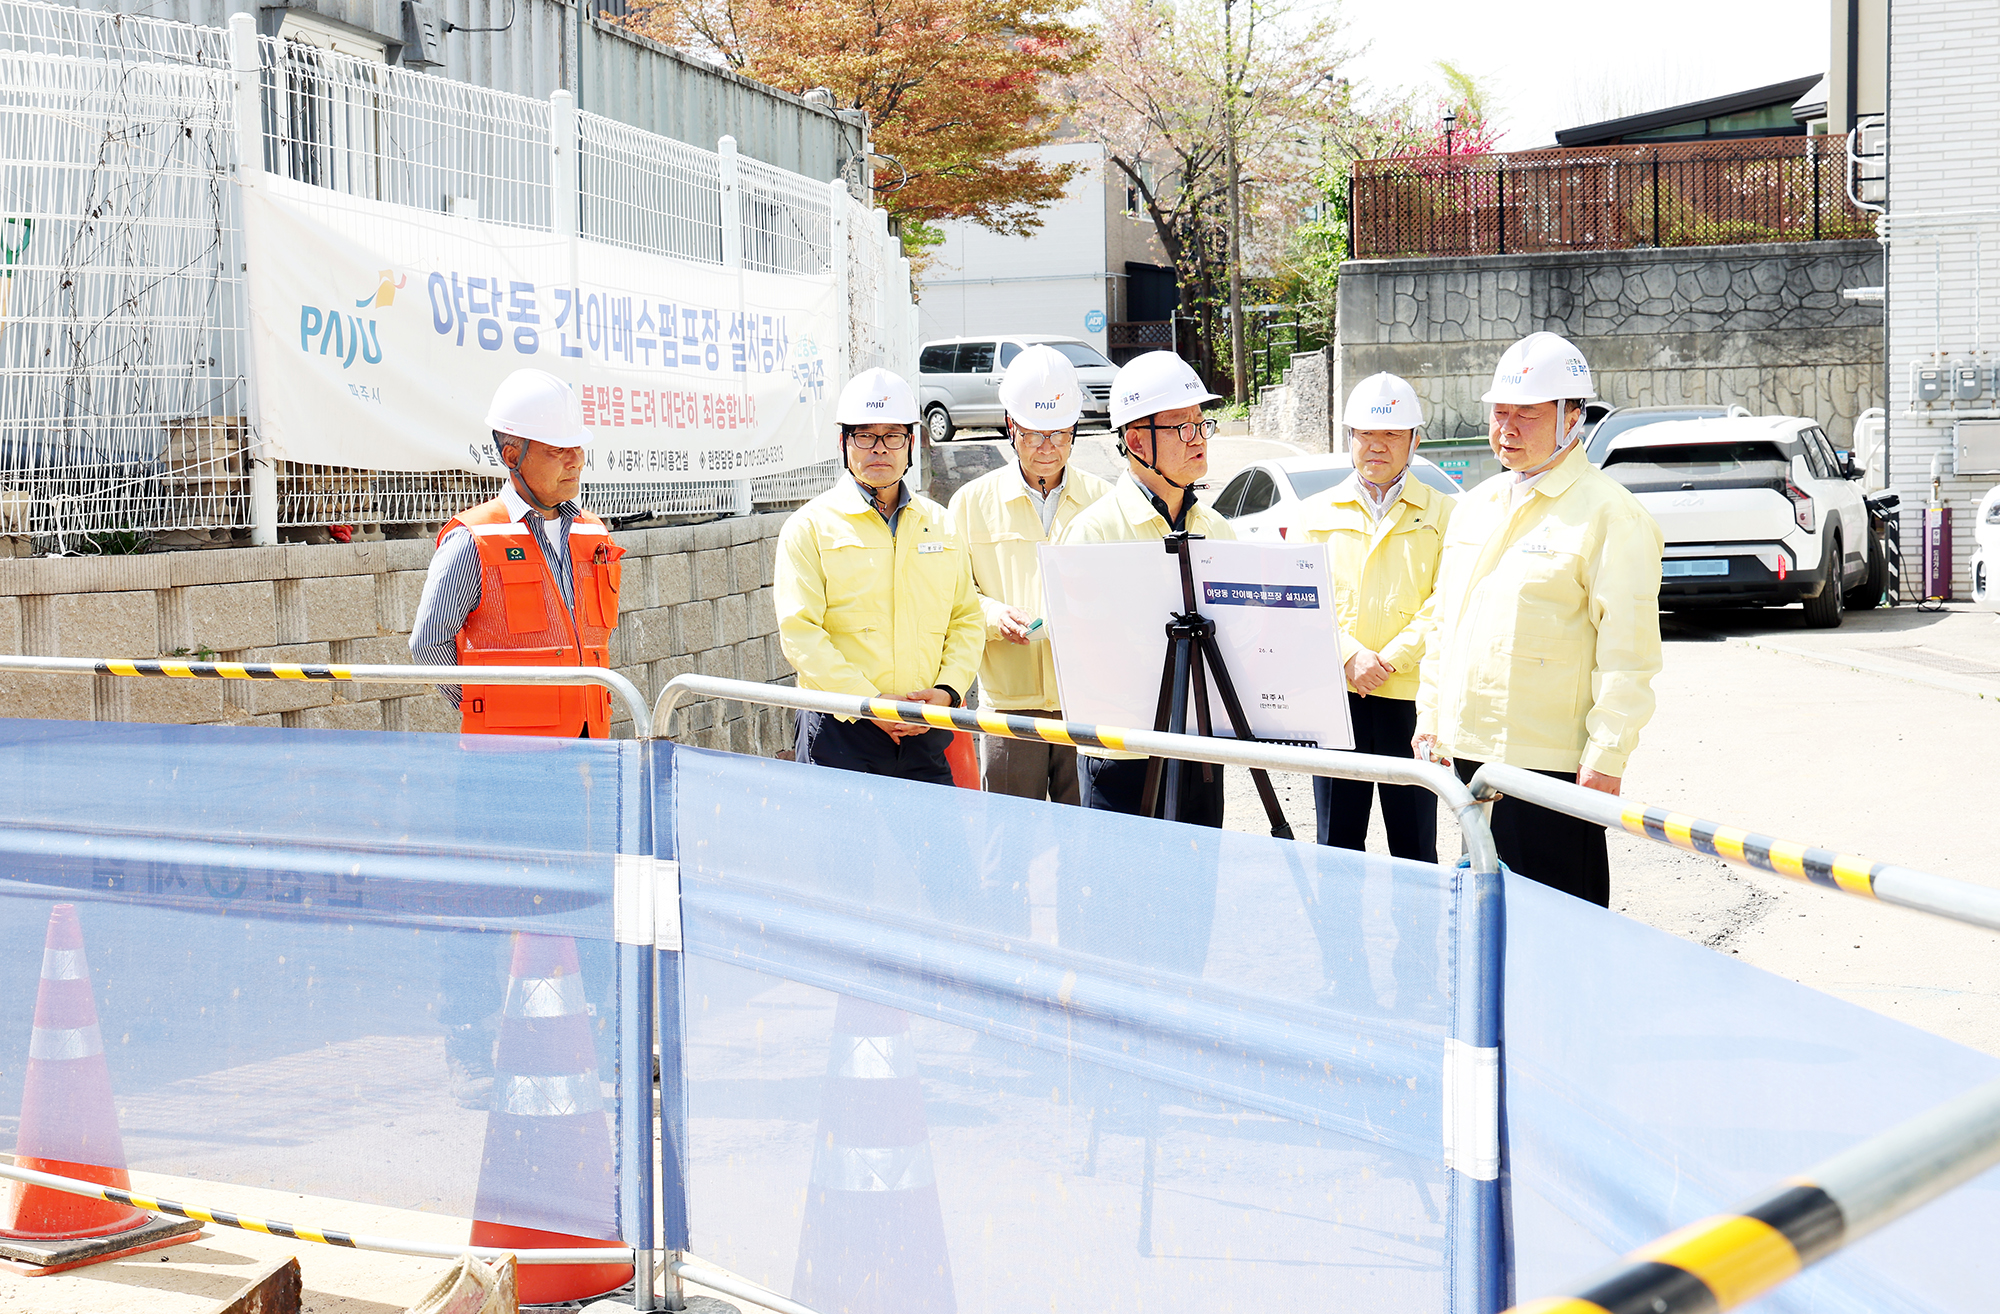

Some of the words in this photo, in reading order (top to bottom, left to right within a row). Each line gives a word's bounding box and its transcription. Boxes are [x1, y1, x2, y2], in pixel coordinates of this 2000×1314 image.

[428, 271, 540, 354] 야당동
[554, 287, 721, 371] 간이배수펌프장
[728, 311, 788, 373] 설치공사
[1088, 316, 1103, 326] ADT
[300, 304, 383, 369] PAJU
[1501, 374, 1522, 385] PAJU
[1185, 381, 1200, 390] PAJU
[348, 383, 381, 405] 파주시
[581, 384, 625, 427] 불편을
[630, 389, 656, 428] 드려
[660, 390, 699, 429] 대단히
[702, 393, 759, 430] 죄송합니다.
[866, 401, 884, 409] PAJU
[1035, 401, 1056, 410] PAJU
[1371, 405, 1392, 414] PAJU
[618, 449, 644, 471] 시공자:
[646, 449, 689, 472] (주)대흥건설
[708, 450, 733, 470] 현장담당
[1206, 588, 1229, 599] 야당동
[1231, 589, 1282, 601] 간이배수펌프장
[1285, 592, 1316, 602] 설치사업
[1261, 693, 1285, 701] 파주시
